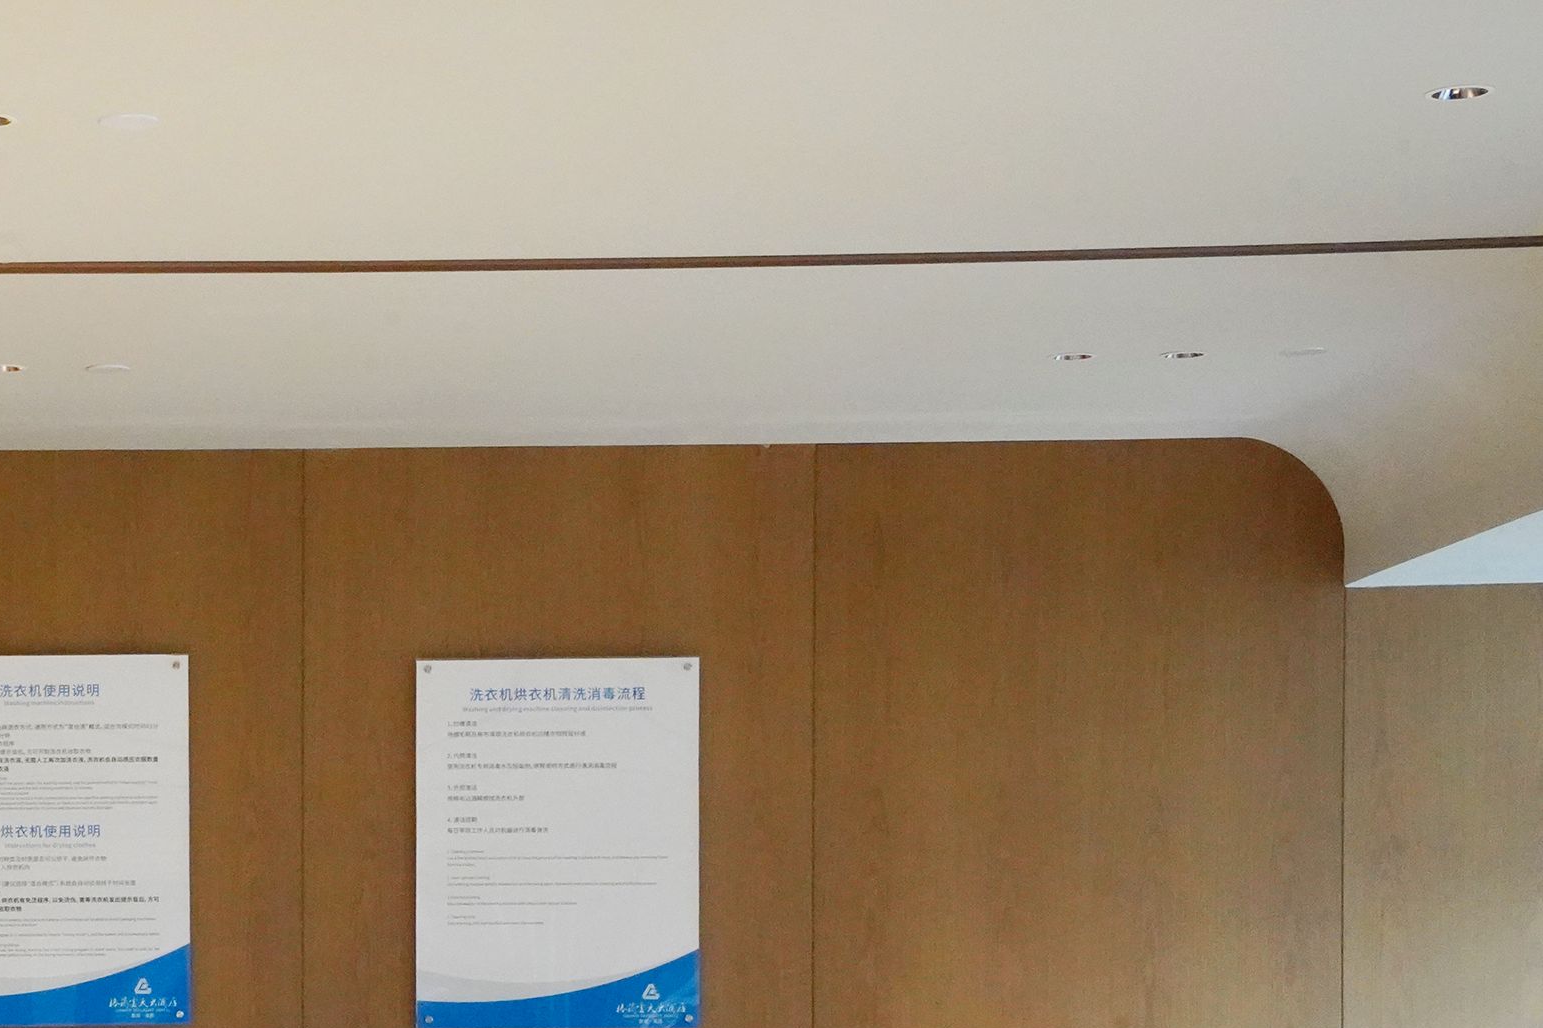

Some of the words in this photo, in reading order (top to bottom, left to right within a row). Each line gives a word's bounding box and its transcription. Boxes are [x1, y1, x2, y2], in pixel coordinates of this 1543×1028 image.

[0, 683, 100, 698] 洗衣机使用说明
[470, 687, 646, 702] 洗衣机烘衣机清洗消毒流程
[0, 824, 101, 839] 烘衣机使用说明
